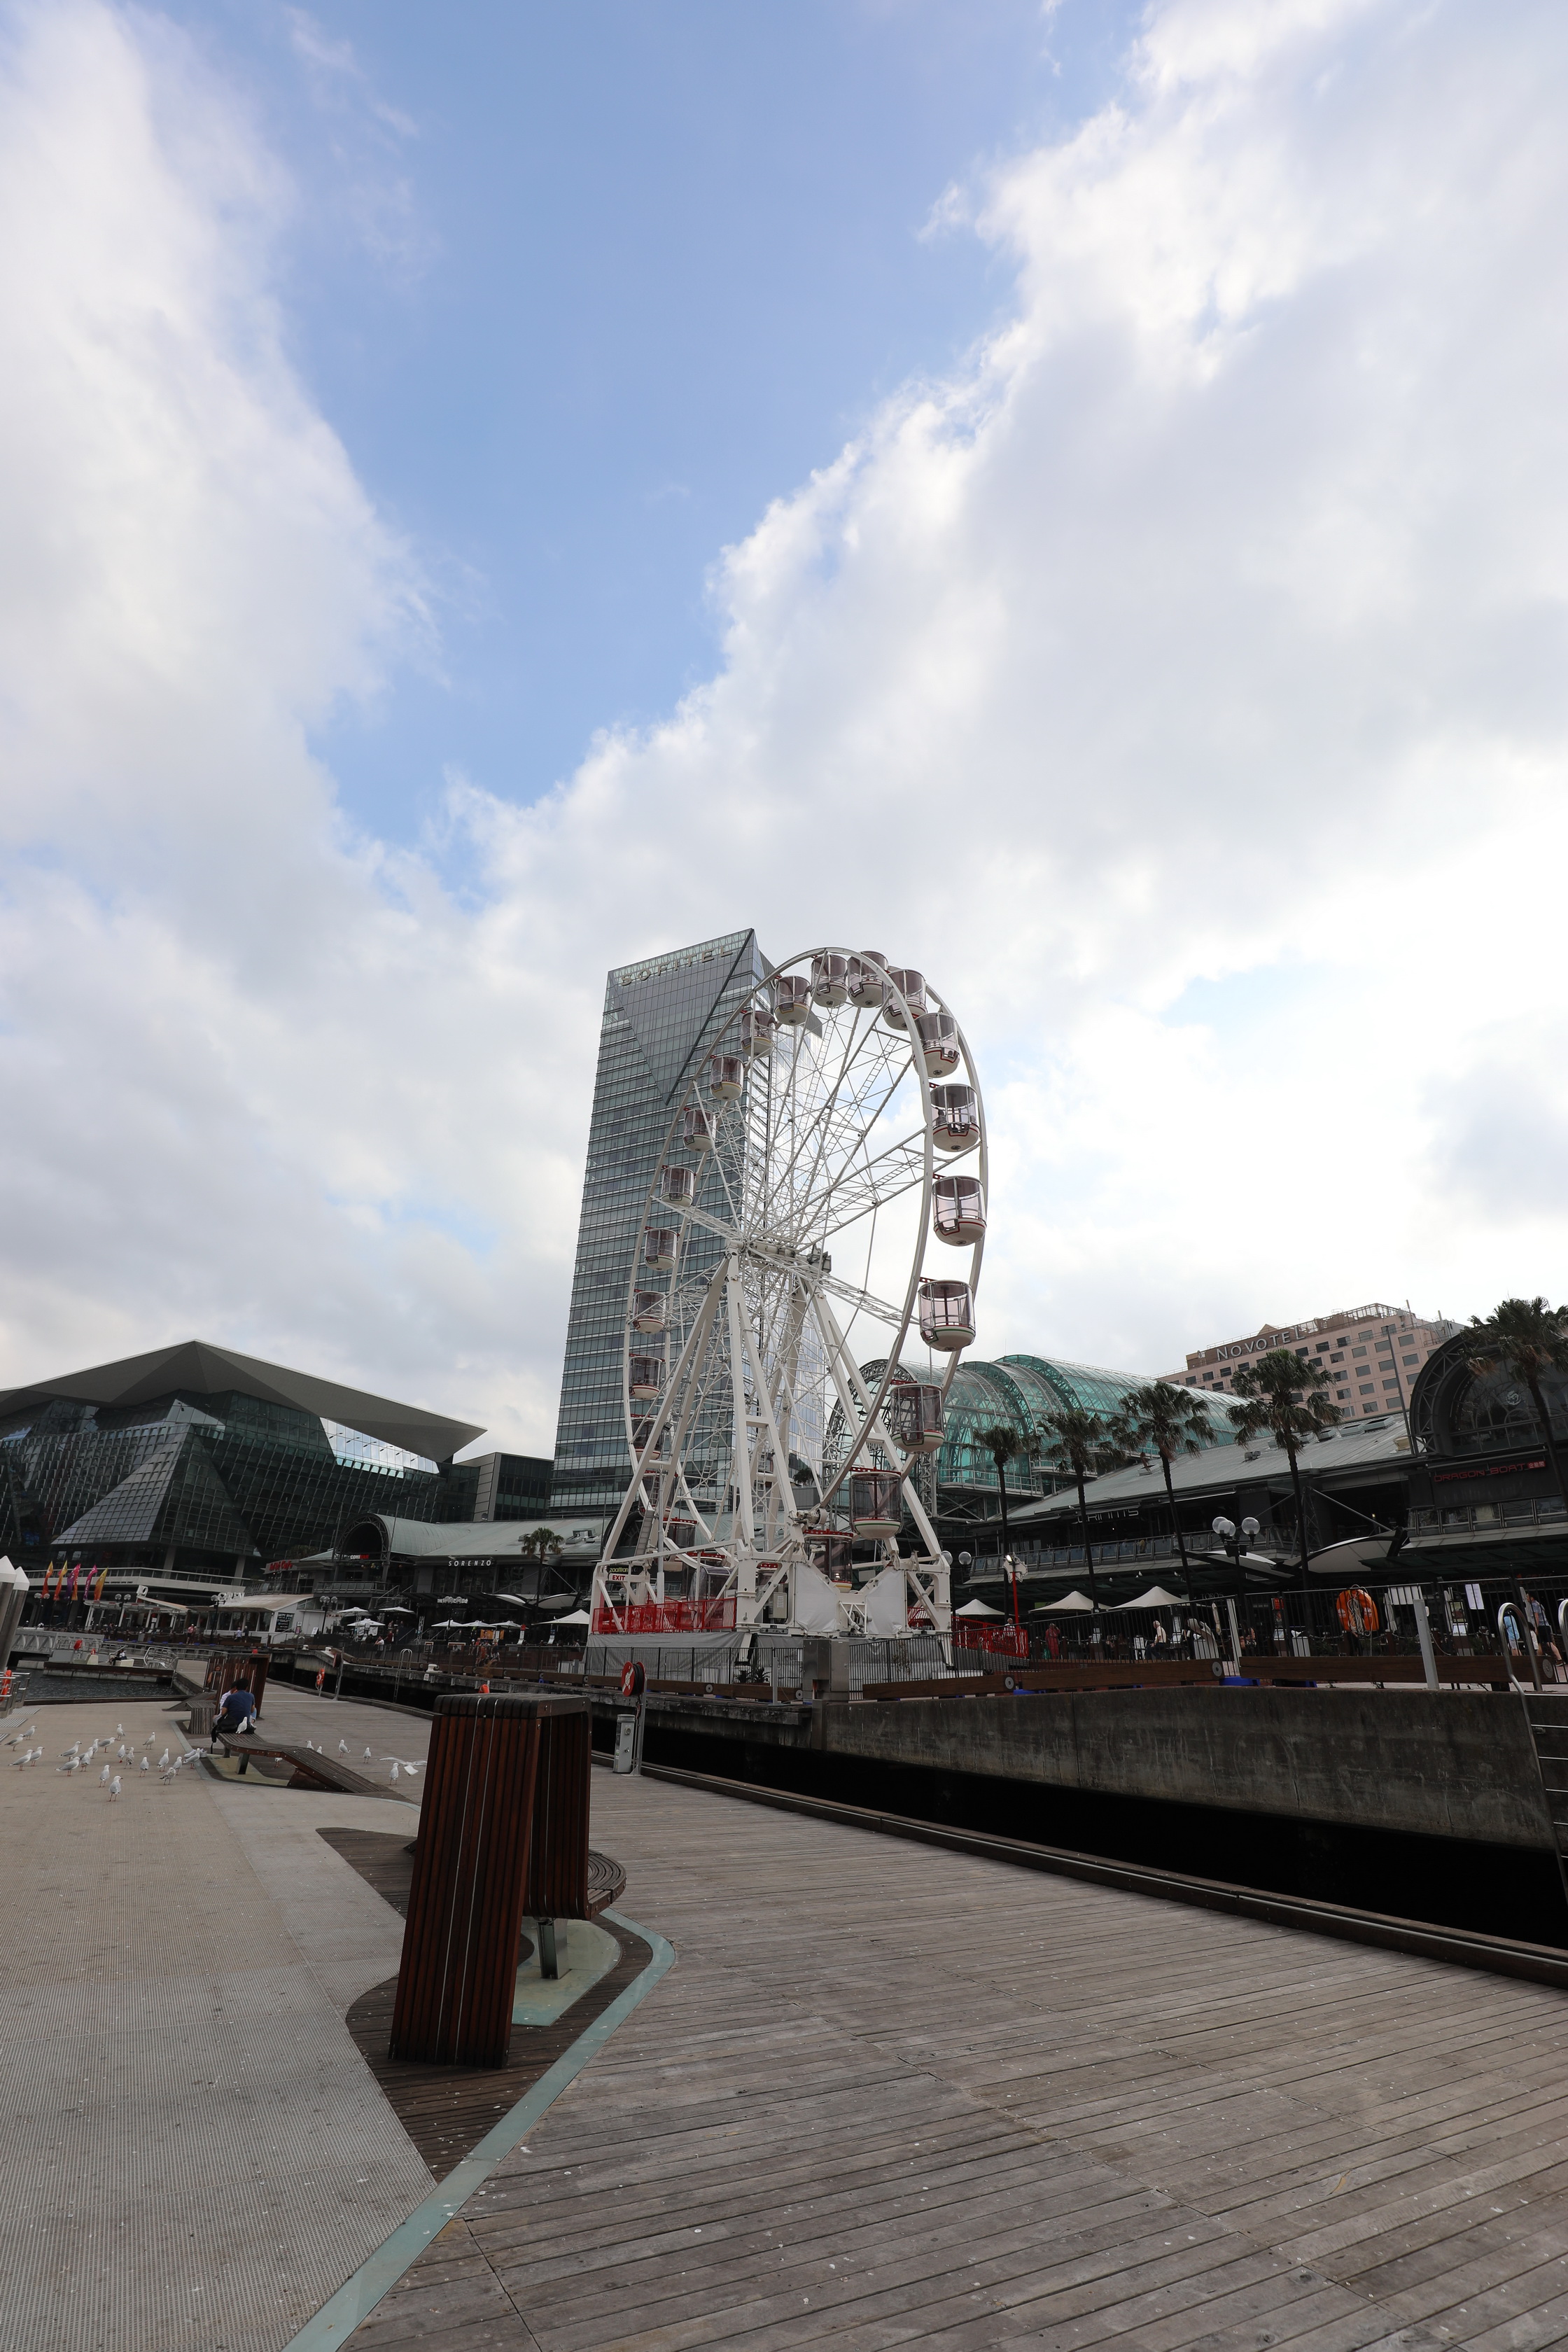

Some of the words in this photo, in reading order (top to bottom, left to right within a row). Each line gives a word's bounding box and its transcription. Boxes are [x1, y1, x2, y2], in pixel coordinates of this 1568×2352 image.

[621, 946, 733, 986] SOFITEL
[1217, 1327, 1306, 1362] NOVOTEL
[1434, 1469, 1485, 1482] DRAGON
[1490, 1463, 1525, 1475] BOAT
